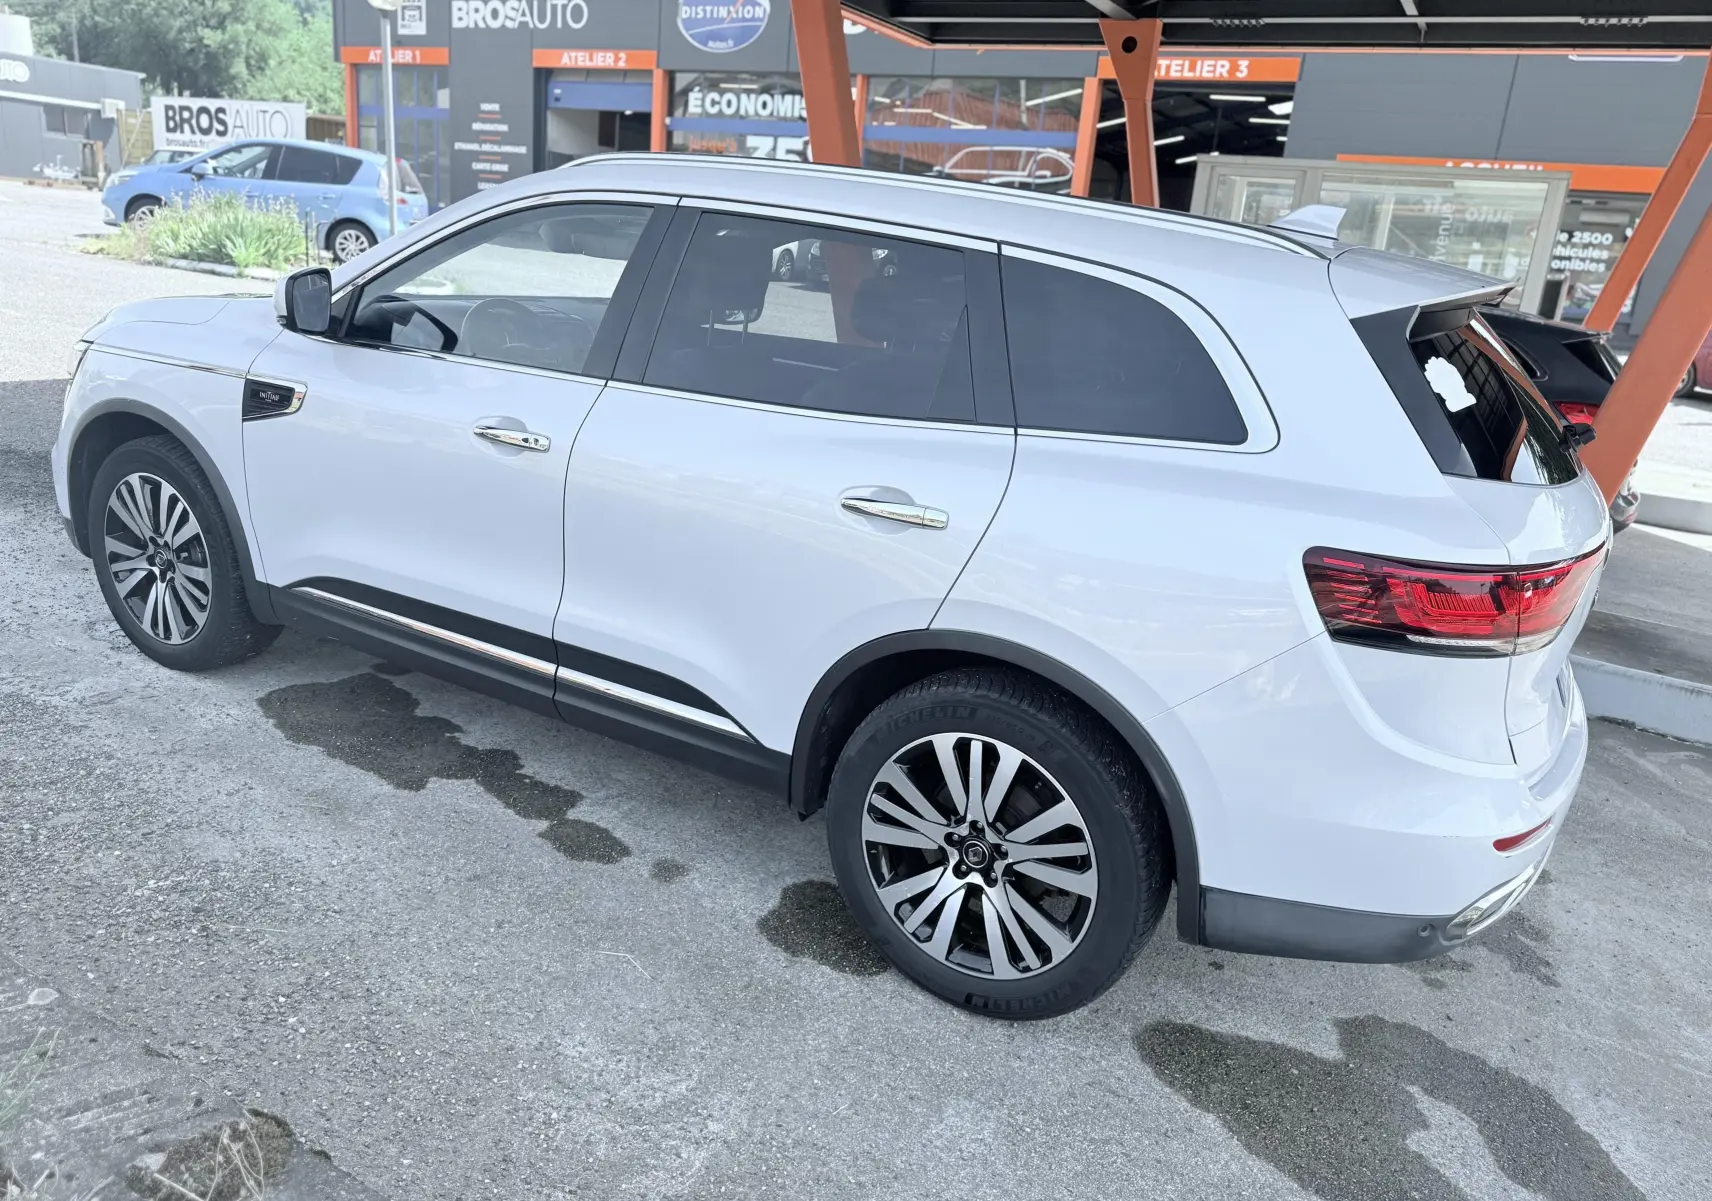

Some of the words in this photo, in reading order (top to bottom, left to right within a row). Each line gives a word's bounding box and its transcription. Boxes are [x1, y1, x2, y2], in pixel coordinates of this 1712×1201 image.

[681, 5, 764, 19] DISTINXION
[368, 50, 413, 64] ATIER
[415, 50, 421, 64] 1
[560, 53, 613, 67] ATELIER
[617, 53, 627, 67] 2
[1154, 60, 1229, 77] TELIER
[1236, 60, 1249, 78] 3
[687, 86, 808, 118] ÉCONOMI
[1571, 231, 1613, 245] 2500
[1553, 244, 1609, 260] hicules
